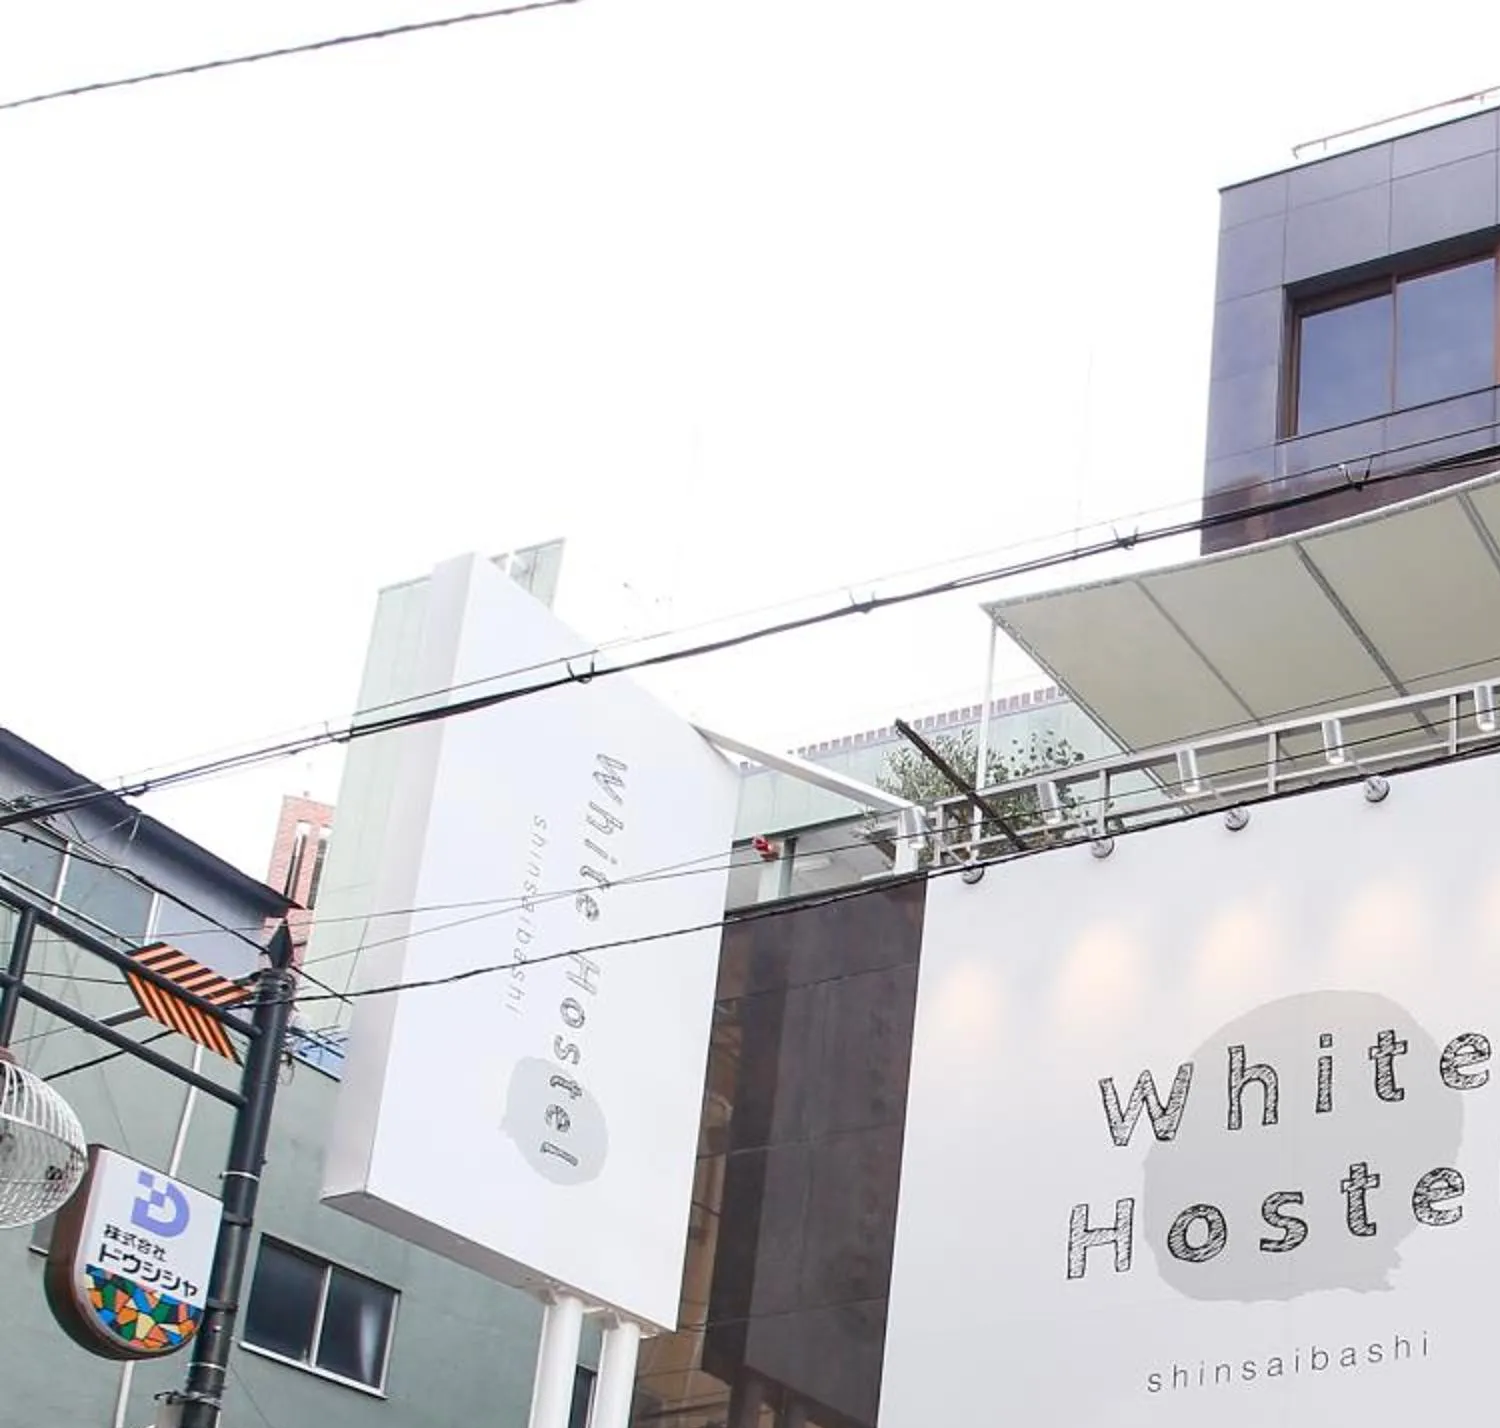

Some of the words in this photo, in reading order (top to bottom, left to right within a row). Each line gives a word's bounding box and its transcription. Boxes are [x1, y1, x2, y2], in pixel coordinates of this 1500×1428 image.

[572, 753, 629, 922] White
[539, 950, 601, 1167] Hostel
[1098, 1029, 1492, 1147] White
[98, 1243, 199, 1297] ドウシシャ
[1146, 1330, 1430, 1394] shinsaibashi
